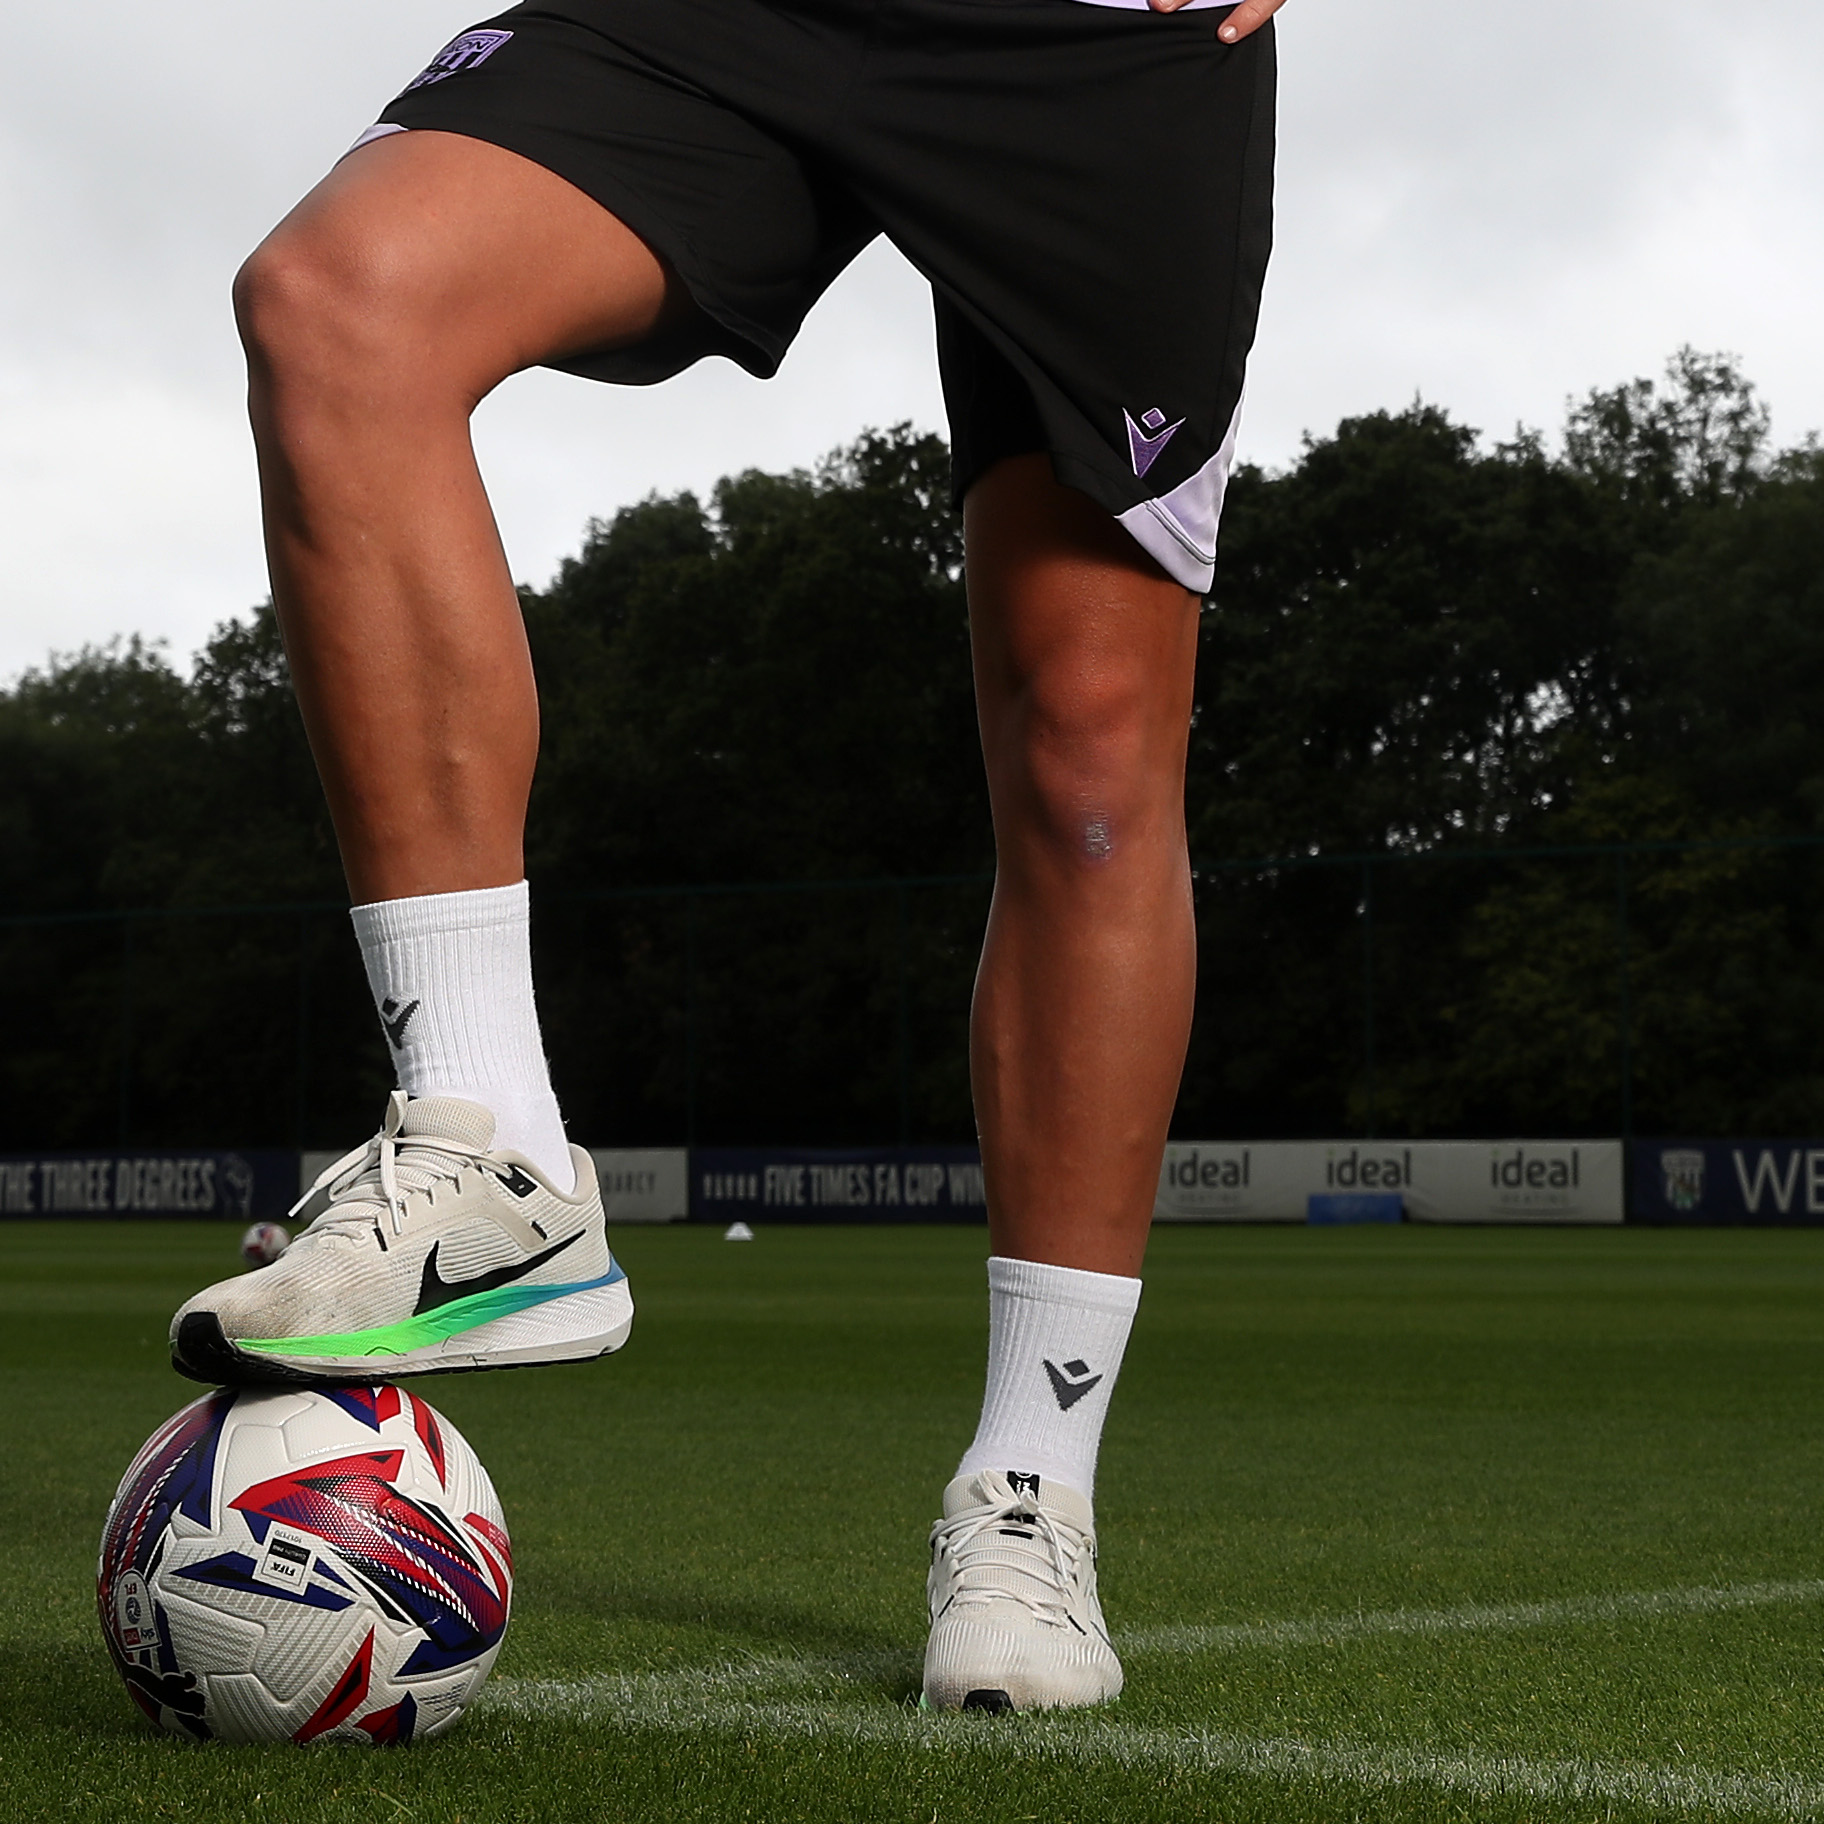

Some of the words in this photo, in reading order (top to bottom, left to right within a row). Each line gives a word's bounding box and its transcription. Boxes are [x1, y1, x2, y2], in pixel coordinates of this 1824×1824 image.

[39, 1160, 112, 1212] THREE
[115, 1157, 216, 1211] DEGREES
[763, 1163, 806, 1207] FIVE
[807, 1163, 870, 1207] TIMES
[872, 1163, 901, 1206] FA
[903, 1163, 945, 1206] CUP
[1169, 1149, 1251, 1187] ideal
[1326, 1149, 1412, 1188] ideal
[1491, 1149, 1580, 1188] ideal
[124, 1583, 138, 1595] EFL
[272, 1562, 297, 1577] FIFA
